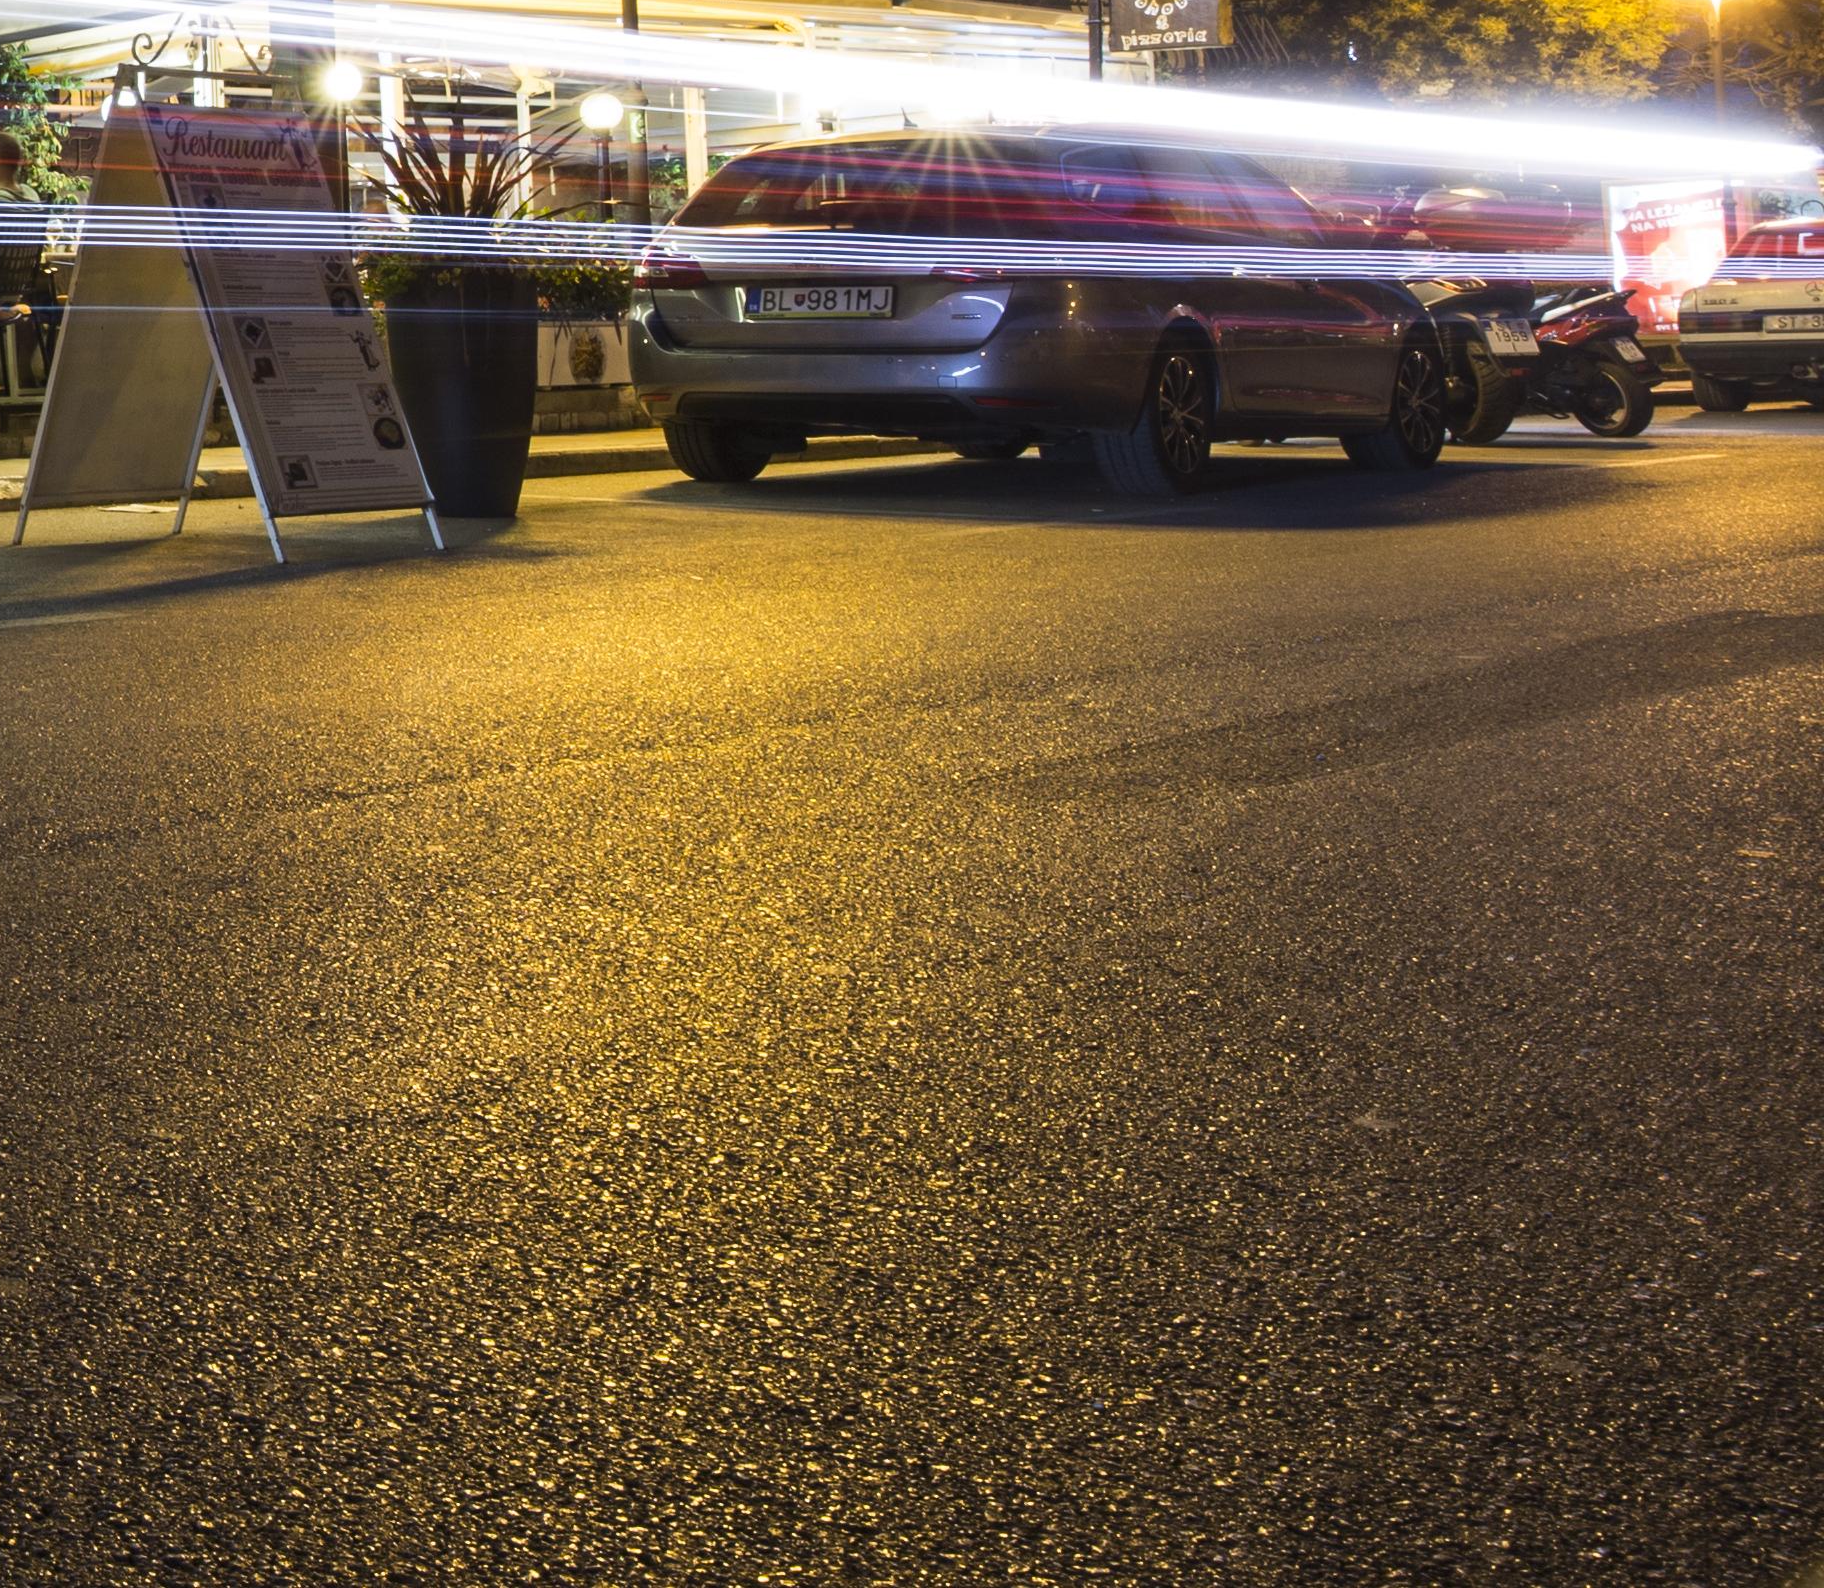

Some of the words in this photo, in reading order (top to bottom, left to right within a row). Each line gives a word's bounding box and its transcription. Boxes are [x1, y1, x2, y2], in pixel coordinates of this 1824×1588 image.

[1121, 27, 1208, 51] pizzeria
[163, 116, 288, 162] Restaurant
[762, 289, 792, 312] BL
[806, 289, 891, 311] 981MJ
[1777, 316, 1799, 329] ST
[1811, 316, 1824, 329] 3
[1495, 331, 1529, 342] 1959
